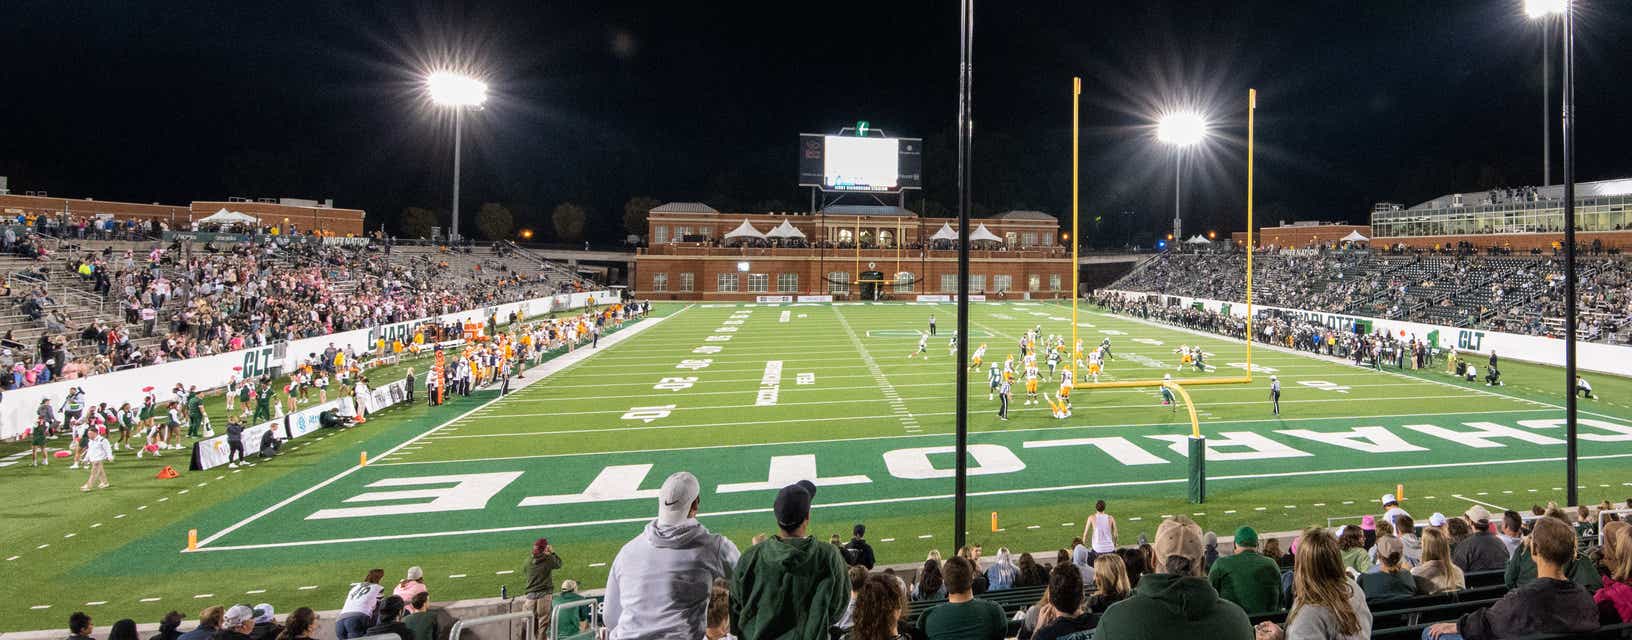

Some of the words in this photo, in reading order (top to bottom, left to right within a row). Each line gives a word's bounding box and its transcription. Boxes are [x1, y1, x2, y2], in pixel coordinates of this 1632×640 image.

[1458, 330, 1484, 351] CLT
[242, 348, 272, 378] CLT
[307, 418, 1632, 519] CHARLOTTE
